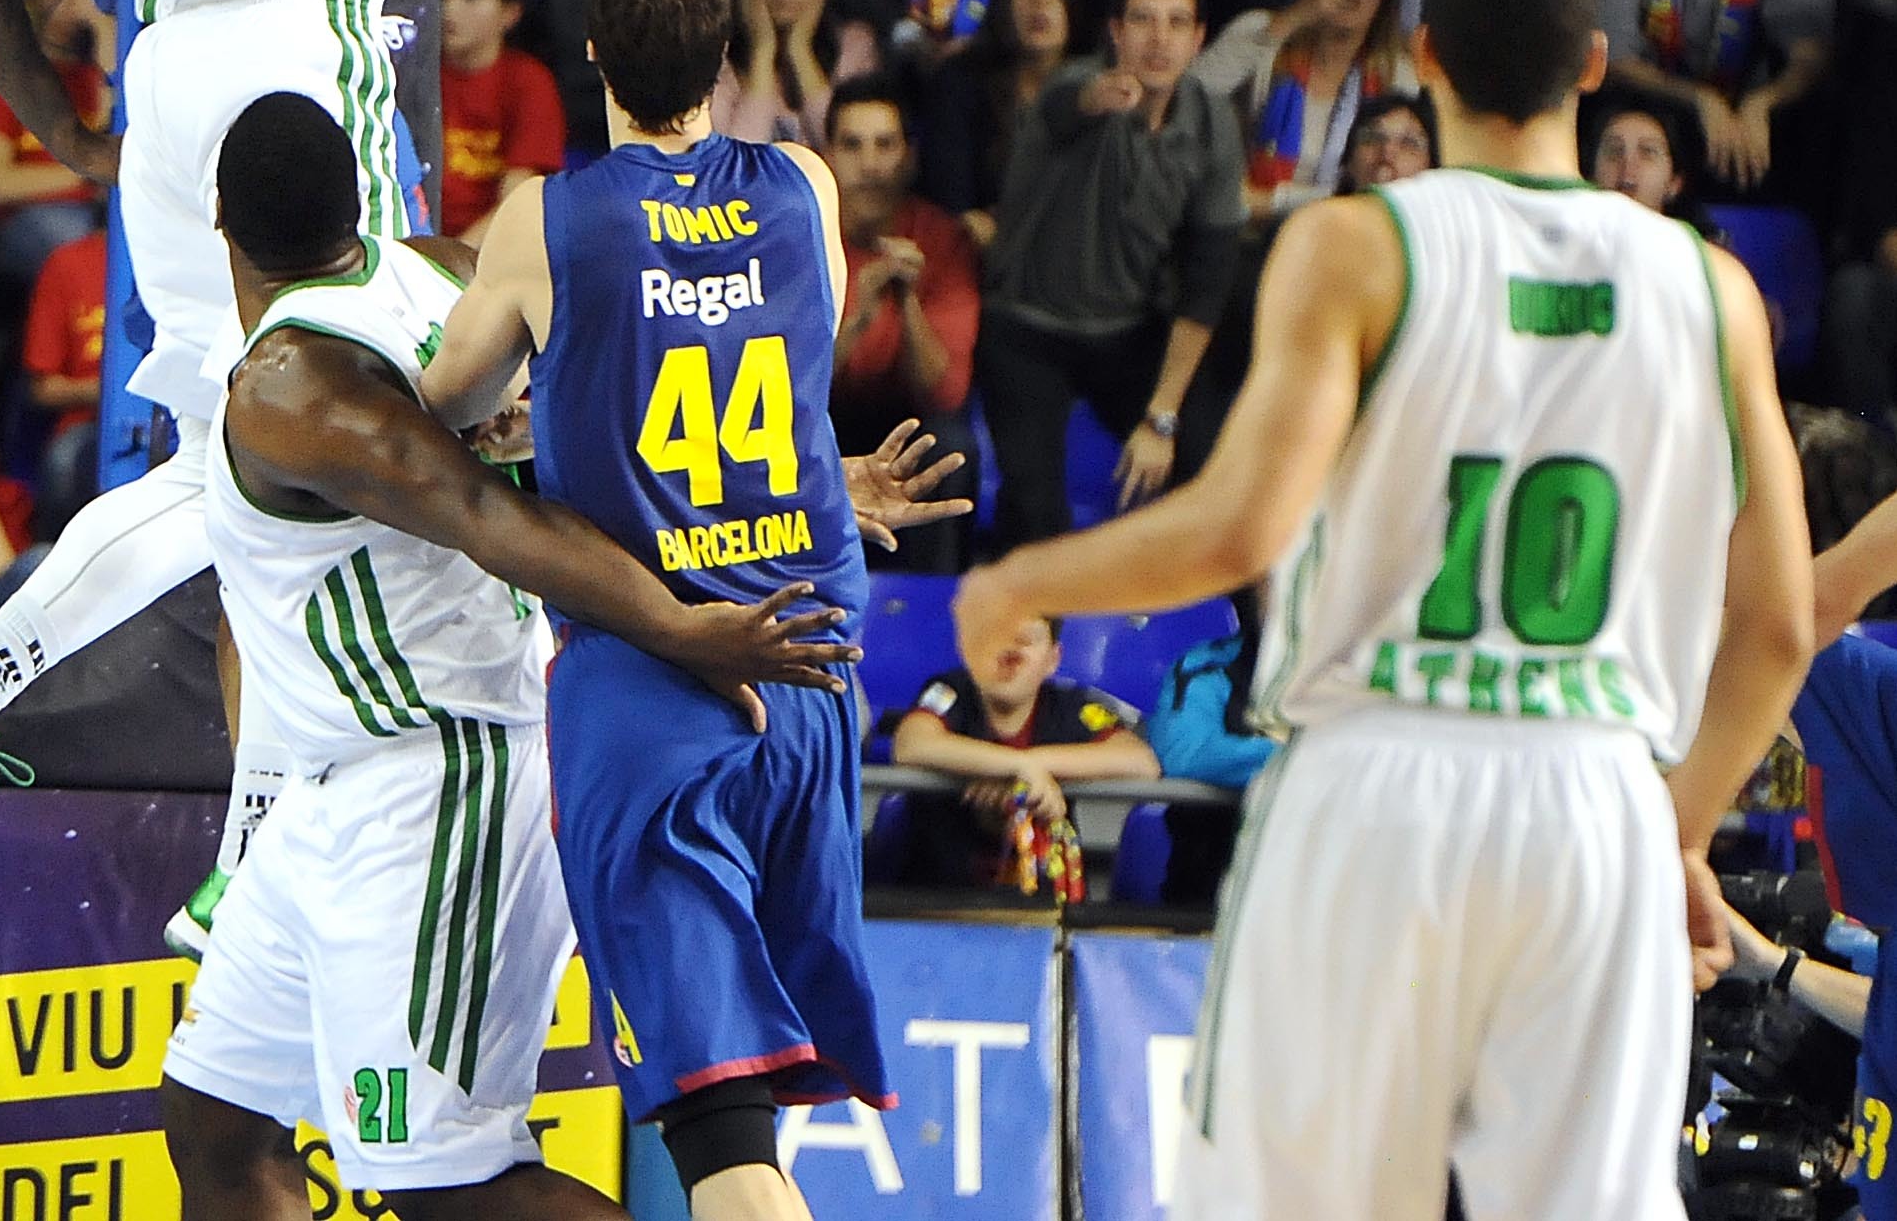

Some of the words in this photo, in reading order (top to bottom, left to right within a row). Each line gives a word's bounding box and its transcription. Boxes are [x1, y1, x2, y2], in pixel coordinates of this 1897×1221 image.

[640, 199, 759, 244] TOMIC
[640, 258, 765, 326] Regal
[636, 335, 799, 508] 44
[656, 509, 814, 573] BARCELONA
[1417, 454, 1620, 646] 10
[1368, 639, 1635, 717] ATHENS
[6, 985, 136, 1077] VIU
[353, 1066, 409, 1144] 21
